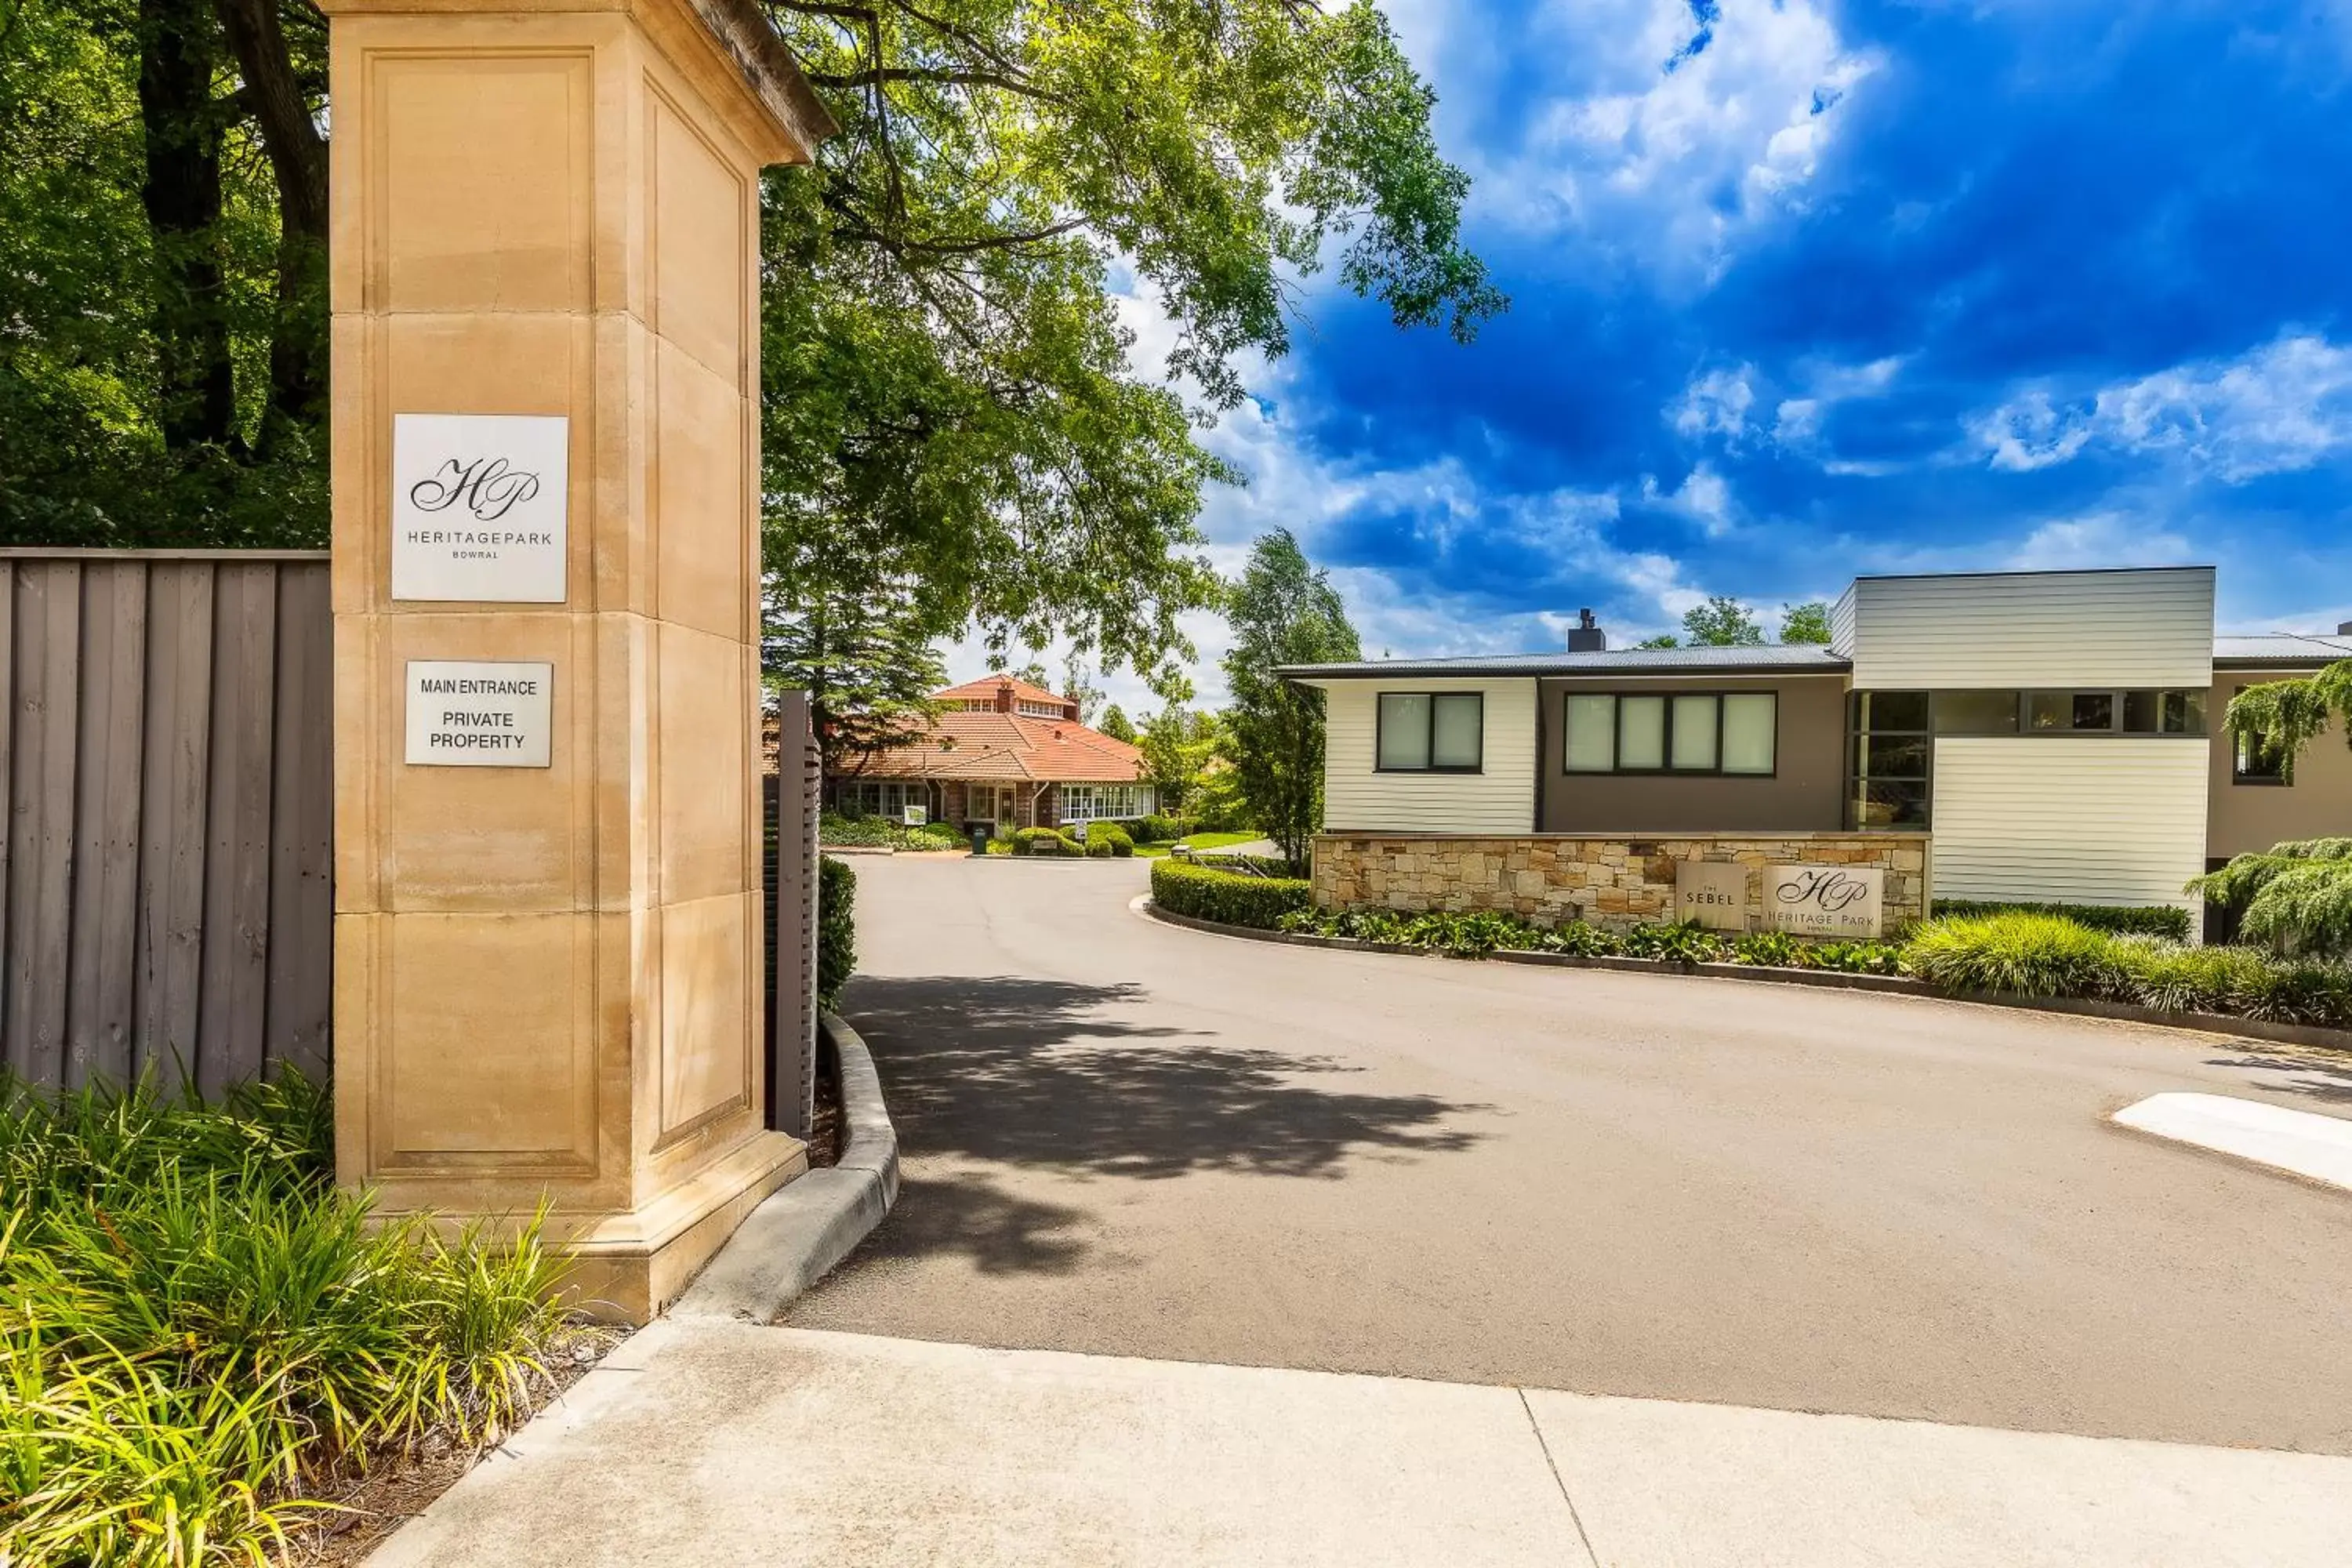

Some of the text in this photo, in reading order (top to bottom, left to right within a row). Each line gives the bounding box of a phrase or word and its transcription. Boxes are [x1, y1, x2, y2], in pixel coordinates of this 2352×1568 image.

[421, 679, 537, 695] MAIN ENTRANCE
[443, 712, 514, 727] PRIVATE
[430, 733, 525, 748] PROPERTY
[1686, 891, 1734, 906] SEBEL
[1768, 910, 1875, 927] HERITAGE PARK
